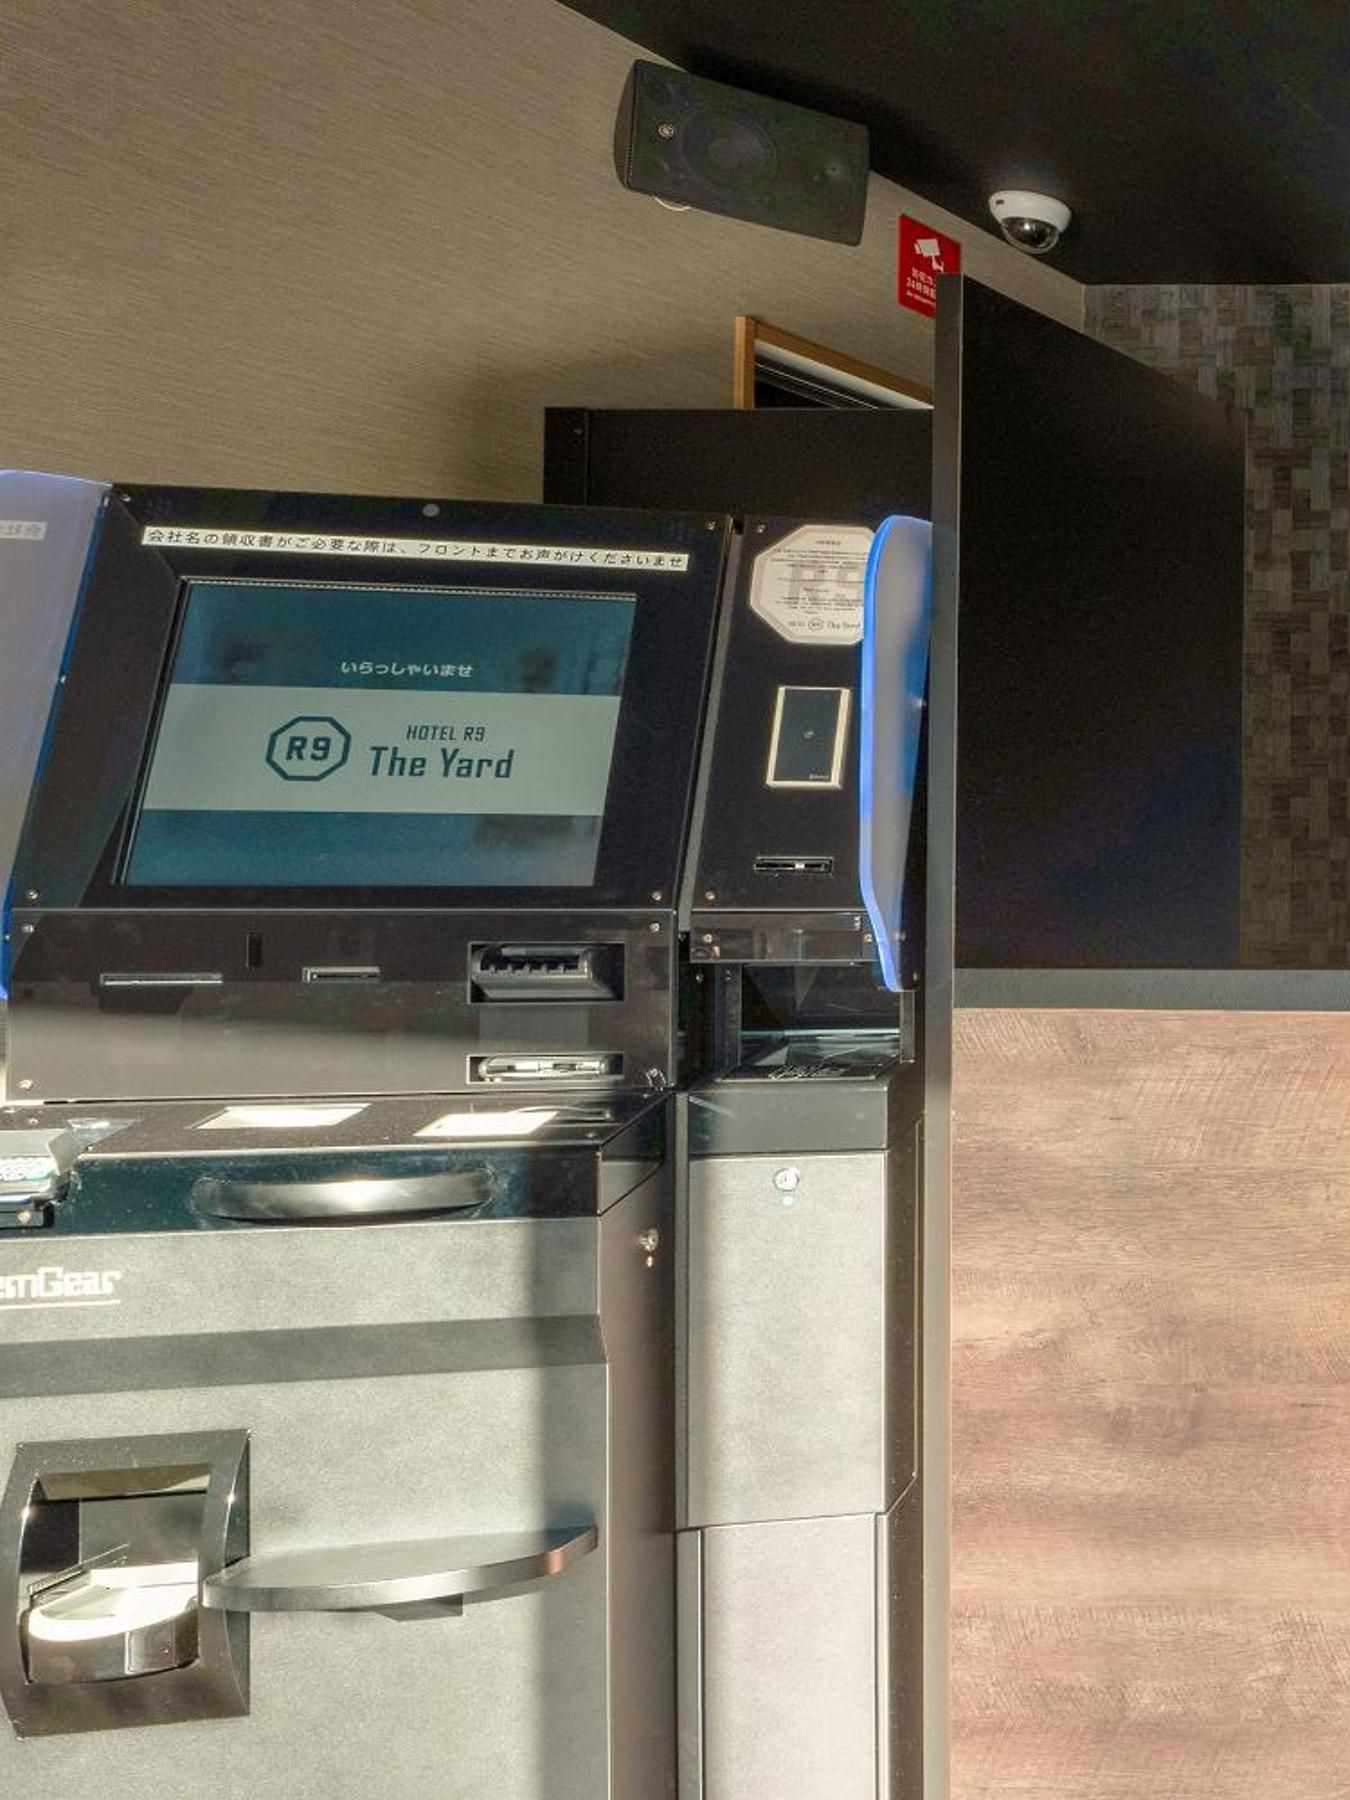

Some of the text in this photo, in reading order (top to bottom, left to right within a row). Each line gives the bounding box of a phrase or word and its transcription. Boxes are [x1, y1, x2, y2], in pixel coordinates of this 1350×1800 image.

[341, 661, 475, 678] いらっしゃいませ
[406, 724, 486, 742] HOTEL R9
[285, 735, 332, 762] R9
[370, 745, 515, 779] The Yard
